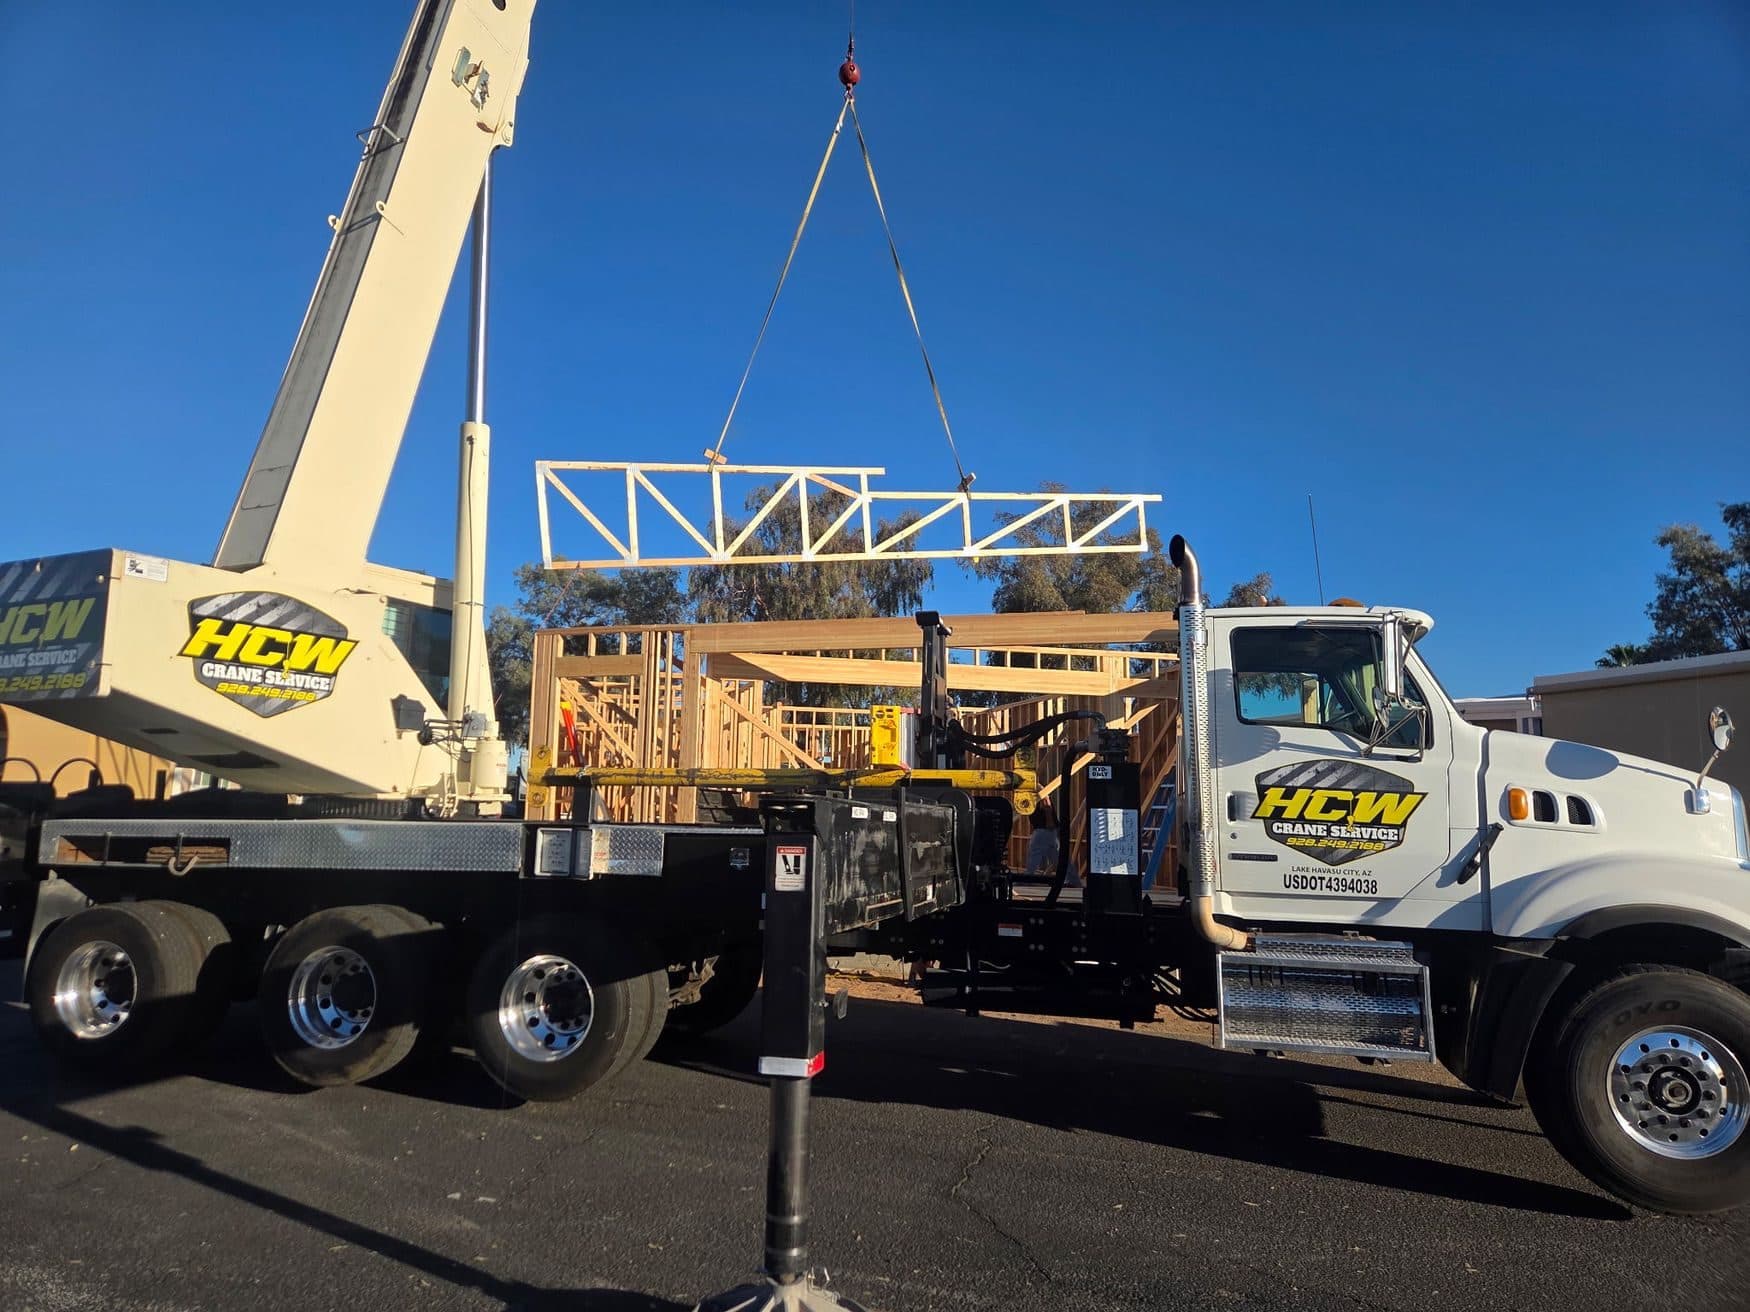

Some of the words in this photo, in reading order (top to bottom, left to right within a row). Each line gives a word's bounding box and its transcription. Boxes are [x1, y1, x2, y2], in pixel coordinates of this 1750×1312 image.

[182, 618, 357, 674] HCW
[27, 649, 77, 666] SERVICE
[202, 662, 263, 684] CRANE
[264, 669, 331, 691] SERVICE
[1255, 788, 1424, 825] HCW
[1272, 822, 1327, 836] CRANE
[1330, 825, 1399, 841] SERVICE
[1286, 837, 1385, 851] 928.249.2188
[1311, 867, 1341, 875] HAVASU
[1283, 873, 1378, 895] USDOT4394038
